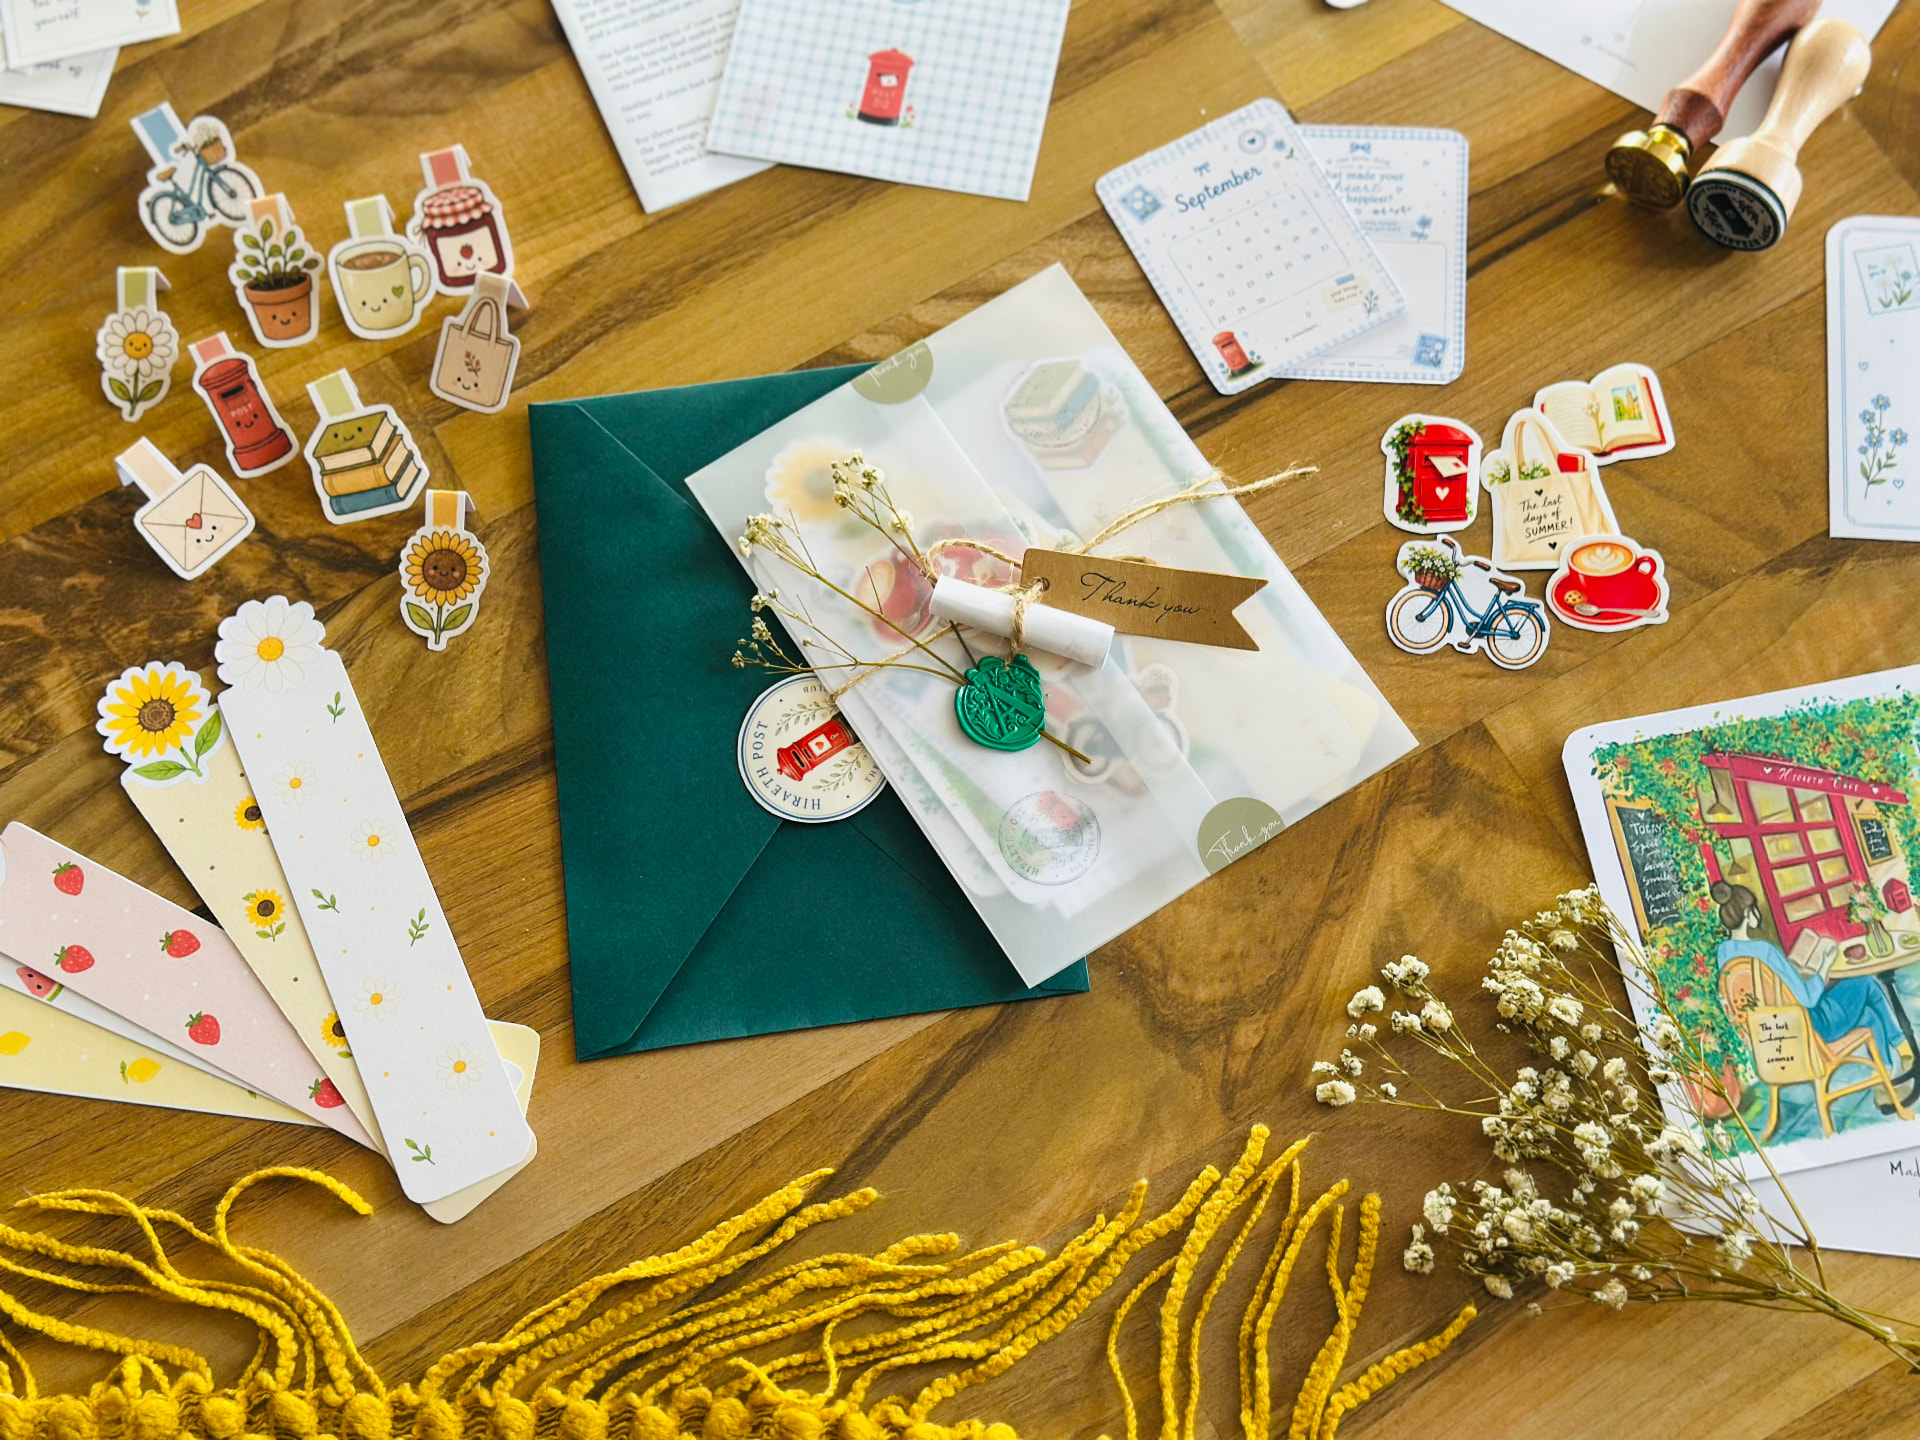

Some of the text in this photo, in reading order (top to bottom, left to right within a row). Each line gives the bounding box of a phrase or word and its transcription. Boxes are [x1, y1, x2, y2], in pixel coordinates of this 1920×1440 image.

[1346, 170, 1376, 180] made
[1380, 173, 1404, 184] your
[1175, 167, 1262, 213] September
[1254, 253, 1262, 261] 17
[1292, 235, 1300, 243] 19
[1310, 226, 1319, 236] 20
[1208, 244, 1329, 307] 21 22 23 24 25 26 27
[1218, 296, 1266, 323] 28 29 30
[230, 402, 252, 418] POST
[1519, 494, 1564, 512] The last
[1523, 506, 1562, 526] days of
[1525, 516, 1572, 538] SUMMER!
[1080, 572, 1201, 623] Thank you
[803, 686, 826, 694] LUB
[752, 720, 821, 810] HIRAETH POST
[1206, 820, 1281, 864] Thank you
[1758, 1022, 1789, 1032] The last
[1776, 1044, 1782, 1054] of
